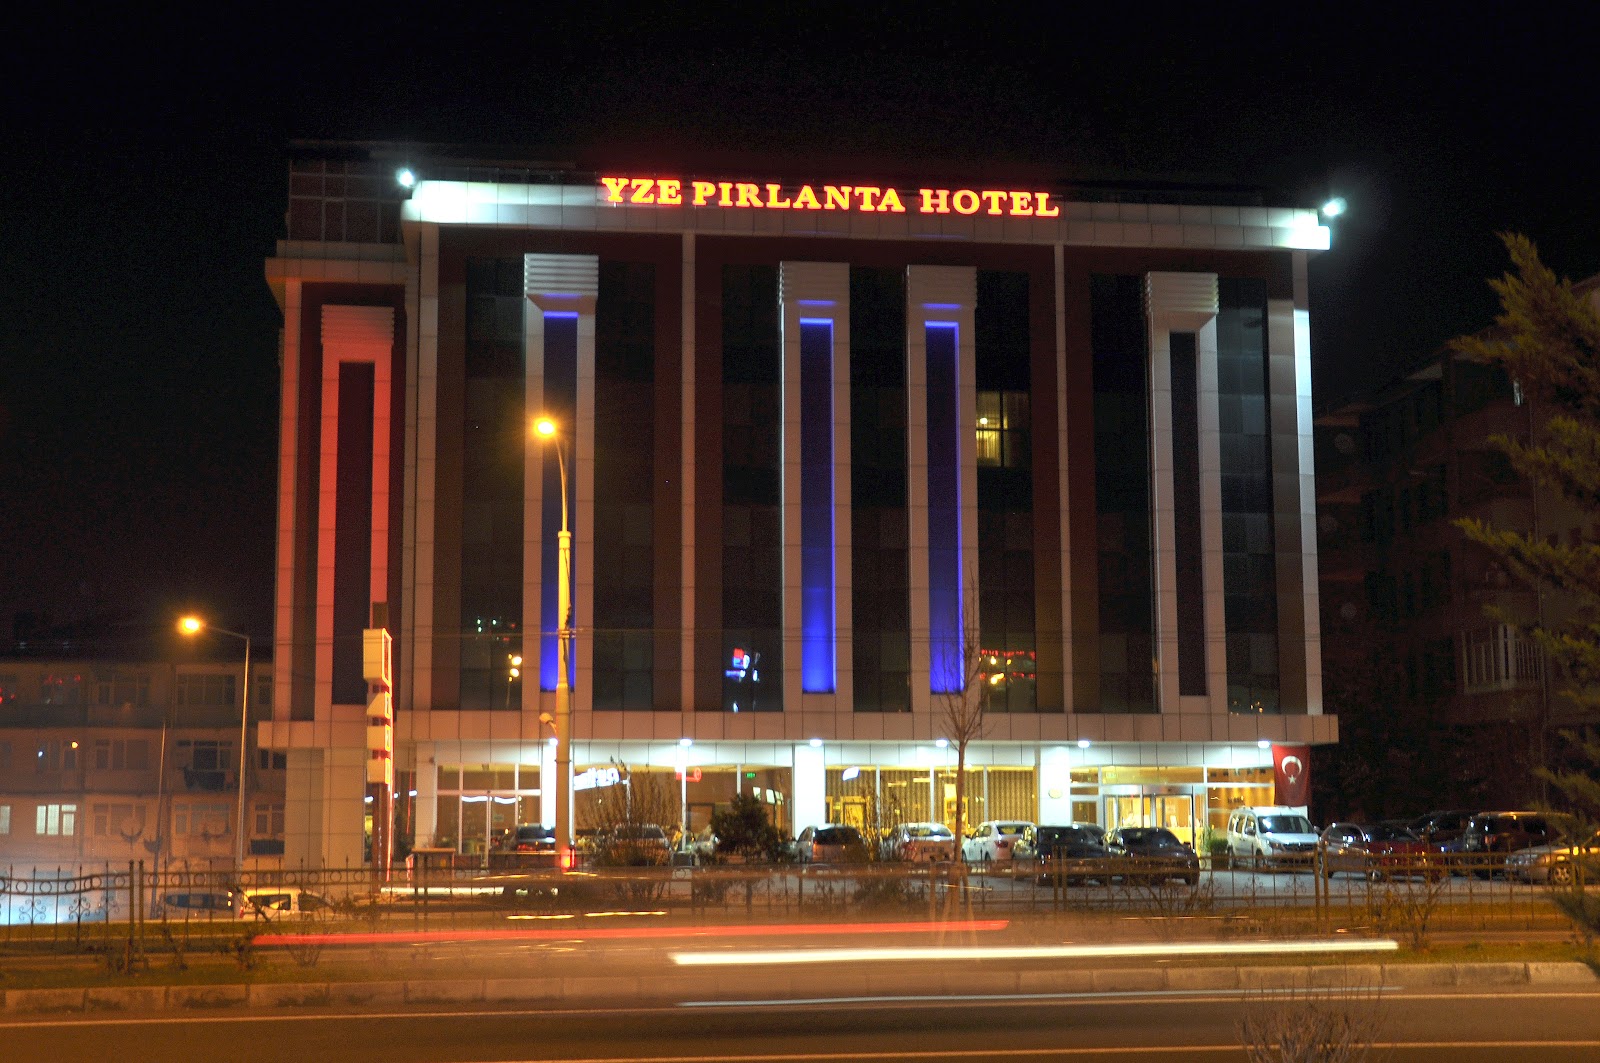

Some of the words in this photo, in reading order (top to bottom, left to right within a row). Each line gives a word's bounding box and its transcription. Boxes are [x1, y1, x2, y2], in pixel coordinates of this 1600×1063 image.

[601, 178, 683, 206] YZE
[692, 181, 906, 213] PIRLANTA
[918, 188, 1060, 217] HOTEL
